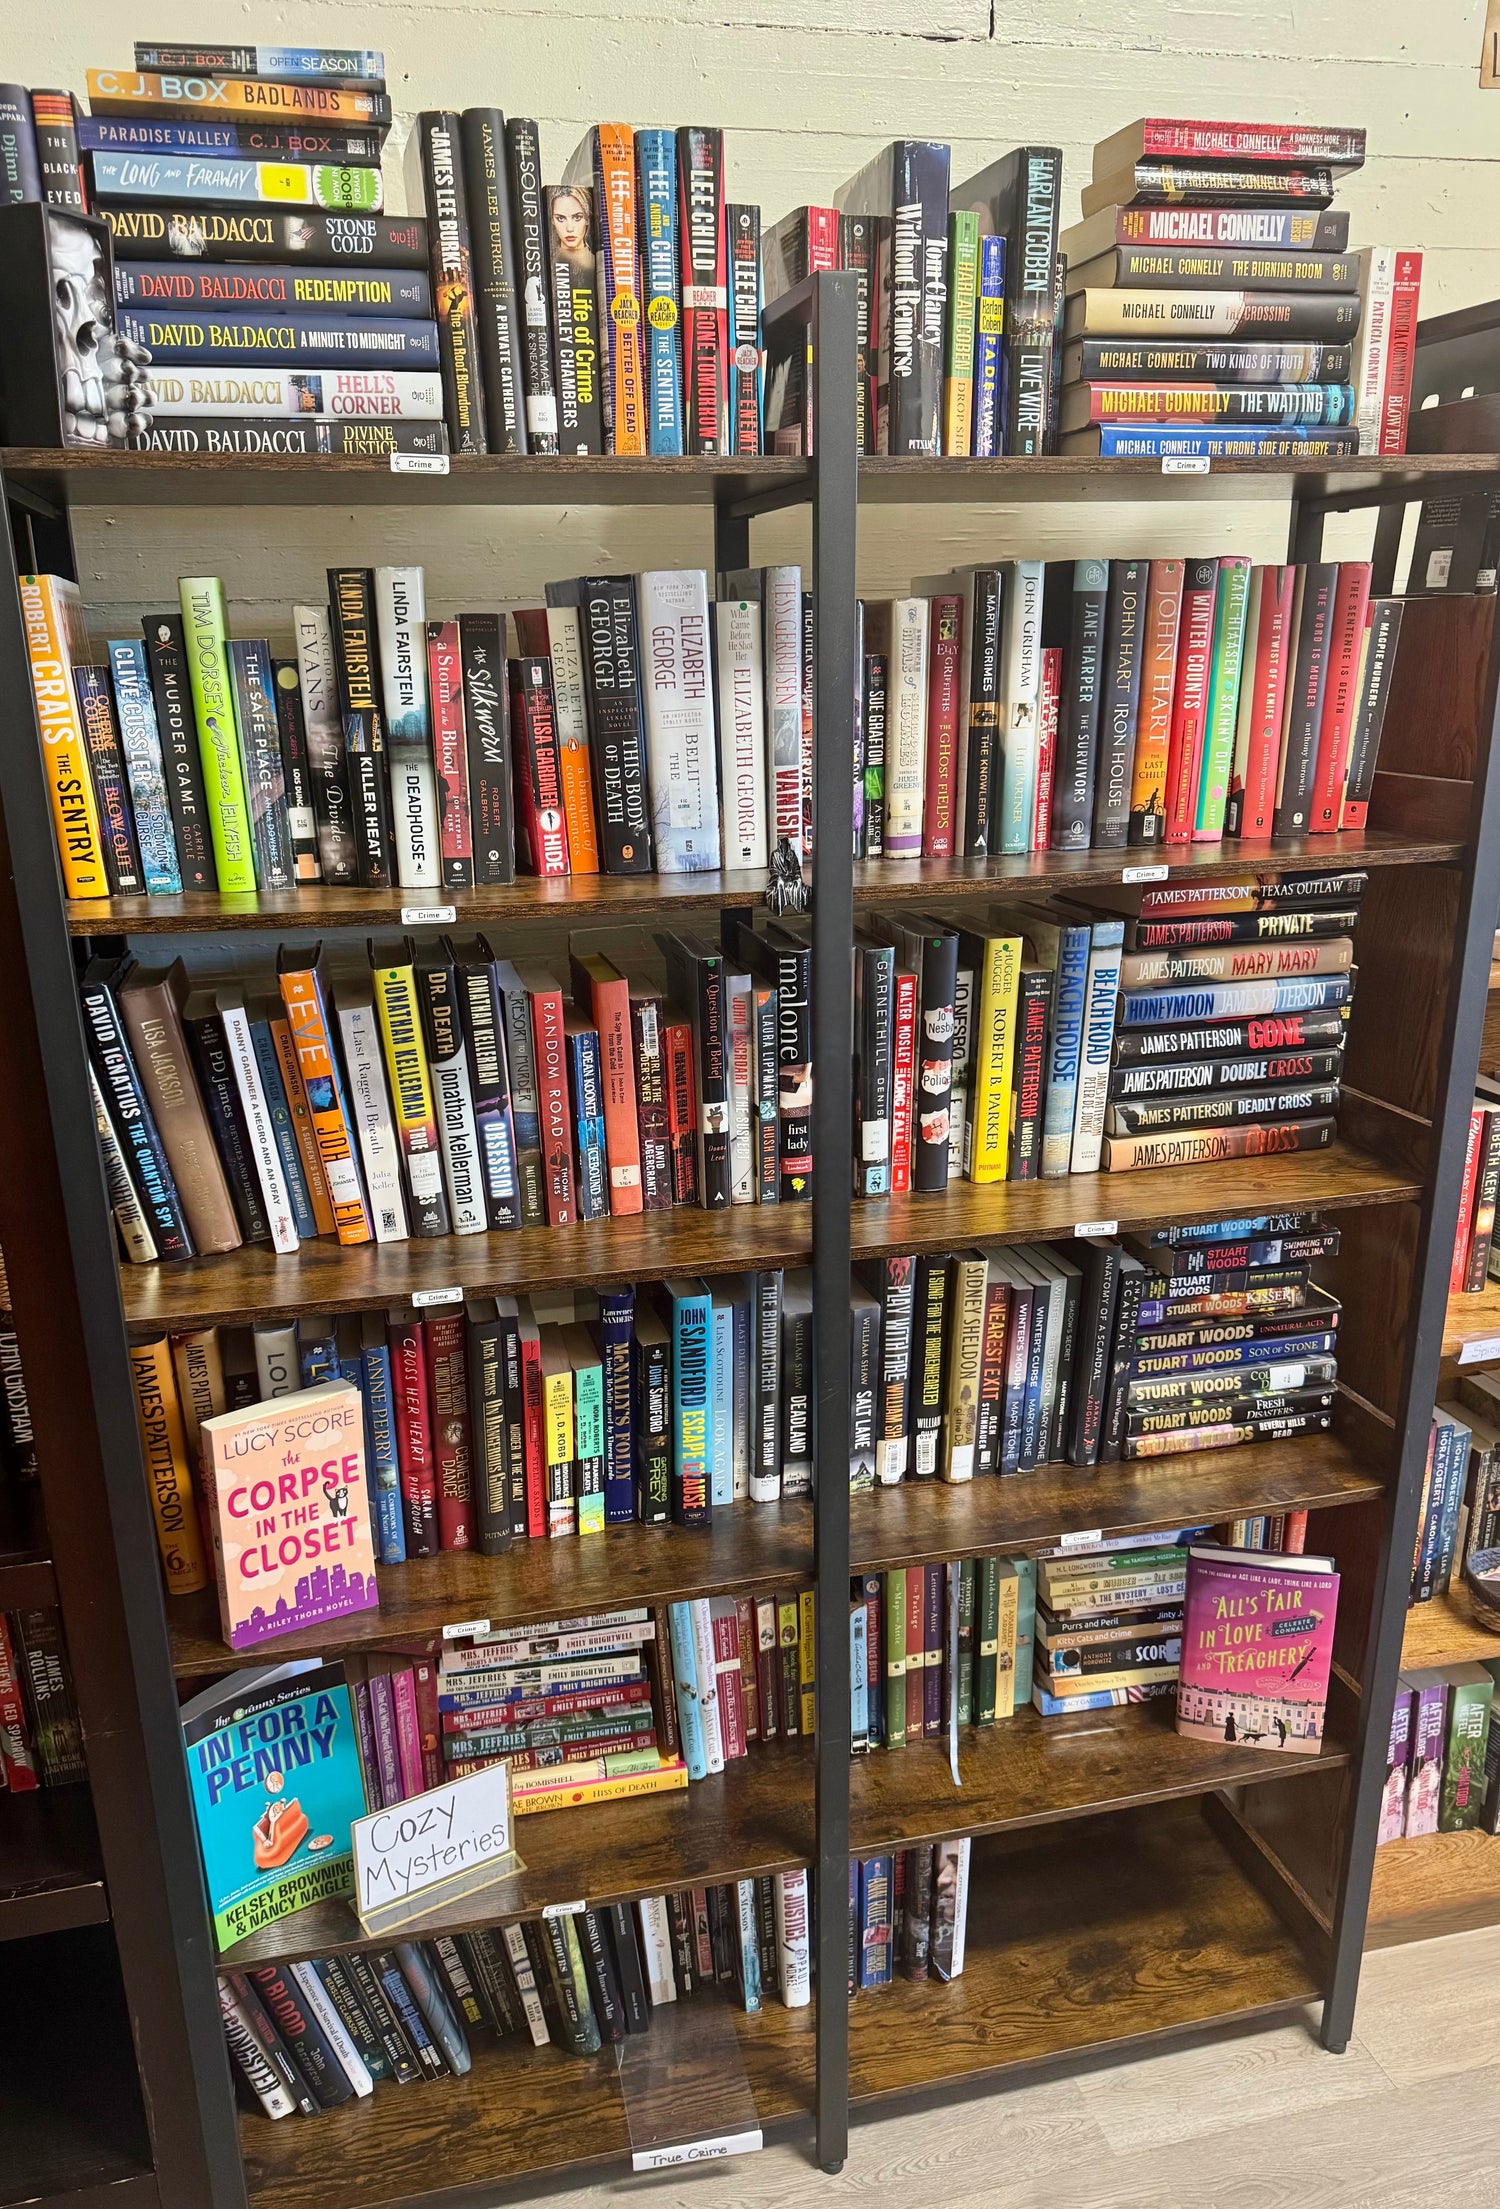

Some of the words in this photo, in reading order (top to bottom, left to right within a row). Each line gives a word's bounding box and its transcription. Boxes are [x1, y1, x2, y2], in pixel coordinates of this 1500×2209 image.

[161, 77, 229, 102] BOX
[244, 85, 340, 110] BADLANDS
[47, 137, 67, 148] THE
[99, 126, 172, 144] PARADISE
[178, 128, 231, 146] VALLEY
[431, 126, 452, 186] JAMES
[102, 164, 117, 176] THE
[120, 162, 160, 187] LONG
[186, 164, 250, 190] FARAWAY
[48, 190, 81, 205] EYED
[436, 189, 456, 216] LEE
[326, 218, 376, 236] STONE
[331, 236, 373, 253] COLD
[438, 220, 461, 271] BURKE
[894, 202, 922, 283] Without
[1149, 212, 1214, 239] MICHAEL
[1218, 214, 1285, 242] CONNELLY
[1130, 257, 1174, 274] MICHAEL
[1178, 259, 1223, 275] CONNELLY
[1232, 261, 1248, 276] THE
[1251, 261, 1292, 277] BURNING
[1296, 263, 1322, 278] ROOM
[140, 274, 194, 299] DAVID
[200, 274, 286, 300] BALDACCI
[295, 279, 390, 302] REDEMPTION
[982, 299, 1002, 316] Harlan
[149, 323, 203, 347] DAVID
[209, 325, 295, 349] BALDACCI
[301, 331, 310, 347] A
[310, 332, 346, 348] MINUTE
[348, 333, 359, 348] TO
[360, 333, 405, 350] MIDNIGHT
[696, 311, 714, 356] GONE
[894, 288, 922, 378] Remorse
[982, 315, 1001, 331] Coben
[331, 394, 402, 414] CORNER
[337, 375, 395, 394] HELL'S
[697, 361, 717, 439] TOMORROW
[407, 460, 432, 469] Crime
[19, 585, 51, 654] ROBERT
[191, 592, 213, 628] TIM
[392, 581, 408, 626] LINDA
[1189, 594, 1211, 649] WINTER
[159, 658, 177, 666] THE
[589, 600, 615, 689] GEORGE
[612, 598, 636, 689] Elizabeth
[198, 636, 226, 717] DORSEY
[396, 632, 413, 706] FAIRSTEIN
[1184, 654, 1205, 709] COUNTS
[31, 661, 75, 746] CRAIS
[164, 673, 186, 754] MURDER
[1081, 714, 1089, 732] THE
[57, 753, 72, 775] THE
[1073, 734, 1089, 802] SURVIVORS
[176, 762, 195, 814] GAME
[58, 779, 95, 866] SENTRY
[406, 776, 425, 861] DEADHOUSE
[544, 833, 563, 872] HIDE
[1261, 883, 1292, 896] TEXAS
[1296, 881, 1342, 894] OUTLAW
[418, 911, 440, 919] Crime
[991, 949, 1001, 996] MUGGER
[1003, 949, 1012, 994] HUGGER
[779, 957, 807, 1061] malone
[1092, 968, 1118, 1018] BEACH
[1129, 993, 1215, 1021] HONEYMOON
[287, 999, 327, 1064] EVE
[876, 961, 888, 1066] GARNETHILL
[544, 1002, 559, 1079] RANDOM
[992, 1008, 1007, 1069] ROBERT
[1089, 1020, 1114, 1066] ROAD
[1140, 1033, 1178, 1055] JAMES
[1180, 1028, 1241, 1051] PATTERSON
[1248, 1017, 1304, 1050] GONE
[85, 994, 114, 1043] DAVID
[102, 1046, 141, 1119] IGNATIUS
[128, 1121, 144, 1145] THE
[136, 1148, 165, 1207] QUANTUM
[155, 1206, 174, 1228] SPY
[550, 1090, 564, 1137] ROAD
[788, 1124, 807, 1135] first
[986, 1092, 1001, 1152] PARKER
[1138, 1106, 1171, 1126] JAMES
[1173, 1102, 1232, 1121] PATTERSON
[1238, 1096, 1276, 1114] DEADLY
[1278, 1094, 1312, 1110] CROSS
[486, 1121, 513, 1199] OBSESSION
[787, 1139, 808, 1151] lady
[1181, 1227, 1220, 1237] STUART
[1221, 1219, 1258, 1232] WOODS
[1269, 1218, 1300, 1232] LAKE
[428, 1292, 448, 1301] Crime
[986, 1302, 1006, 1362] NEAREST
[403, 1338, 418, 1381] CROSS
[1138, 1355, 1187, 1373] STUART
[1192, 1349, 1242, 1366] WOODS
[1249, 1347, 1270, 1357] SON
[1284, 1341, 1318, 1353] STONE
[406, 1387, 420, 1415] HER
[984, 1366, 1000, 1400] EXIT
[856, 1391, 872, 1418] SALT
[224, 1429, 281, 1460] LUCY
[284, 1409, 356, 1442] SCORE
[408, 1421, 424, 1464] HEART
[789, 1396, 806, 1454] DEADLAND
[854, 1420, 872, 1450] LANE
[1438, 1429, 1448, 1457] NORA
[228, 1454, 360, 1518] CORPSE
[1432, 1460, 1445, 1507] ROBERTS
[256, 1517, 275, 1537] IN
[282, 1502, 319, 1529] THE
[1073, 1534, 1091, 1542] Crime
[239, 1516, 358, 1578] CLOSET
[1062, 1621, 1085, 1631] Purrs
[1086, 1619, 1100, 1629] and
[1102, 1616, 1119, 1628] Peril
[1215, 1594, 1258, 1619] ALL'S
[1261, 1589, 1302, 1610] FAIR
[1057, 1636, 1074, 1646] Kitty
[1076, 1635, 1093, 1644] Cats
[1095, 1632, 1109, 1641] and
[1110, 1628, 1132, 1641] Crime
[1200, 1628, 1215, 1648] IN
[1222, 1625, 1262, 1644] LOVE
[1218, 1645, 1310, 1674] TREACHERY
[199, 1738, 230, 1772] IN
[241, 1705, 309, 1751] FOR
[315, 1695, 339, 1724] A
[1425, 1702, 1442, 1738] AFTER
[206, 1724, 336, 1806] PENNY
[525, 1776, 574, 1790] BOMBSHELL
[593, 1789, 614, 1798] HISS
[616, 1787, 626, 1795] OF
[628, 1781, 657, 1792] DEATH
[371, 1796, 456, 1853] Cozy
[366, 1824, 505, 1905] Mysteries
[226, 1893, 274, 1927] KELSEY
[278, 1859, 354, 1897] BROWNING
[236, 1922, 246, 1936] &
[249, 1899, 296, 1932] NANCY
[301, 1875, 350, 1912] NAIGLE
[782, 1897, 806, 1944] JUSTICE
[650, 2153, 683, 2166] True
